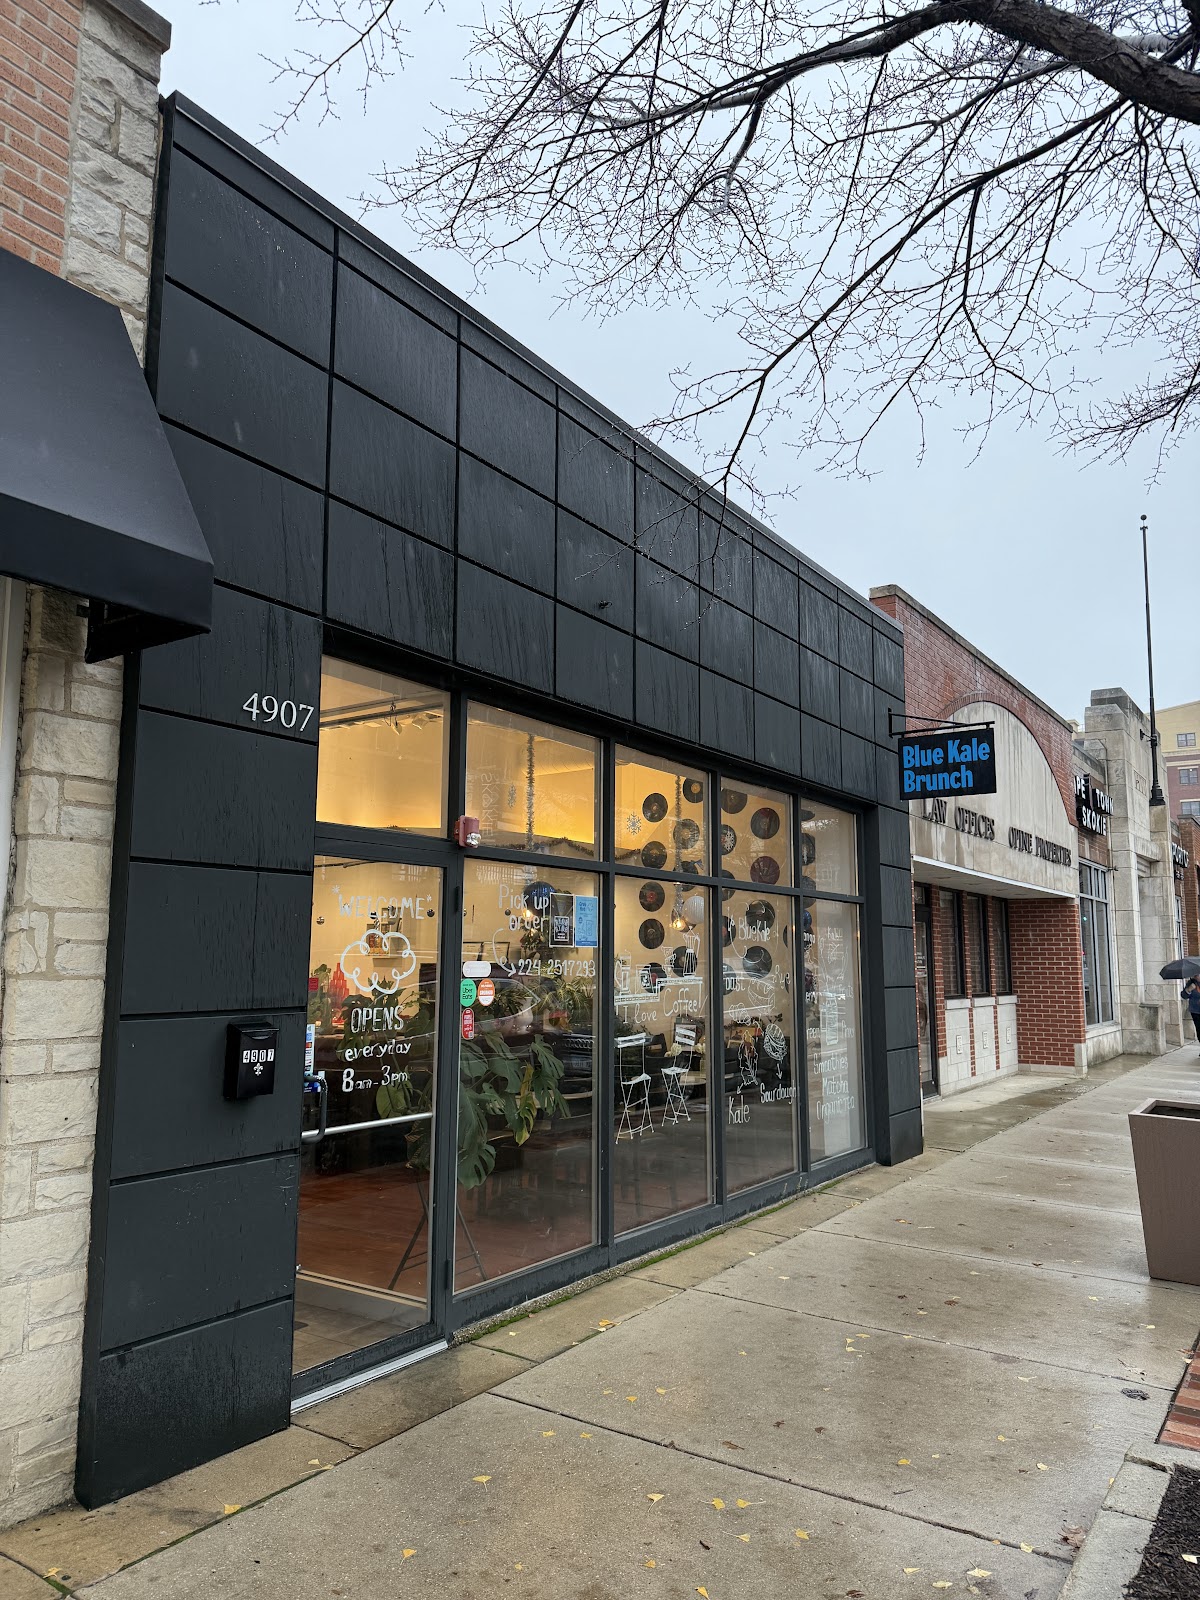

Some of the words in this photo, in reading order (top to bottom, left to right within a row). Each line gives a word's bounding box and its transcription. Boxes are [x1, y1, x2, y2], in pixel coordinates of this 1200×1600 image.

[242, 692, 315, 732] 4907
[903, 744, 944, 769] Blue
[948, 738, 991, 764] Kale
[904, 764, 974, 793] Brunch
[922, 797, 948, 824] LAW
[954, 806, 996, 842] OFFICES
[1082, 805, 1107, 837] SKOKIE
[1034, 835, 1073, 868] PROPERTIES
[337, 893, 426, 920] WELCOME
[498, 883, 530, 910] Pick
[533, 895, 550, 918] up
[508, 914, 551, 933] order
[517, 958, 542, 977] 224
[724, 975, 746, 992] oast
[350, 1004, 405, 1034] OPENS
[242, 1048, 275, 1064] 4907
[344, 1038, 412, 1063] everyday
[760, 1079, 797, 1105] Sourdough
